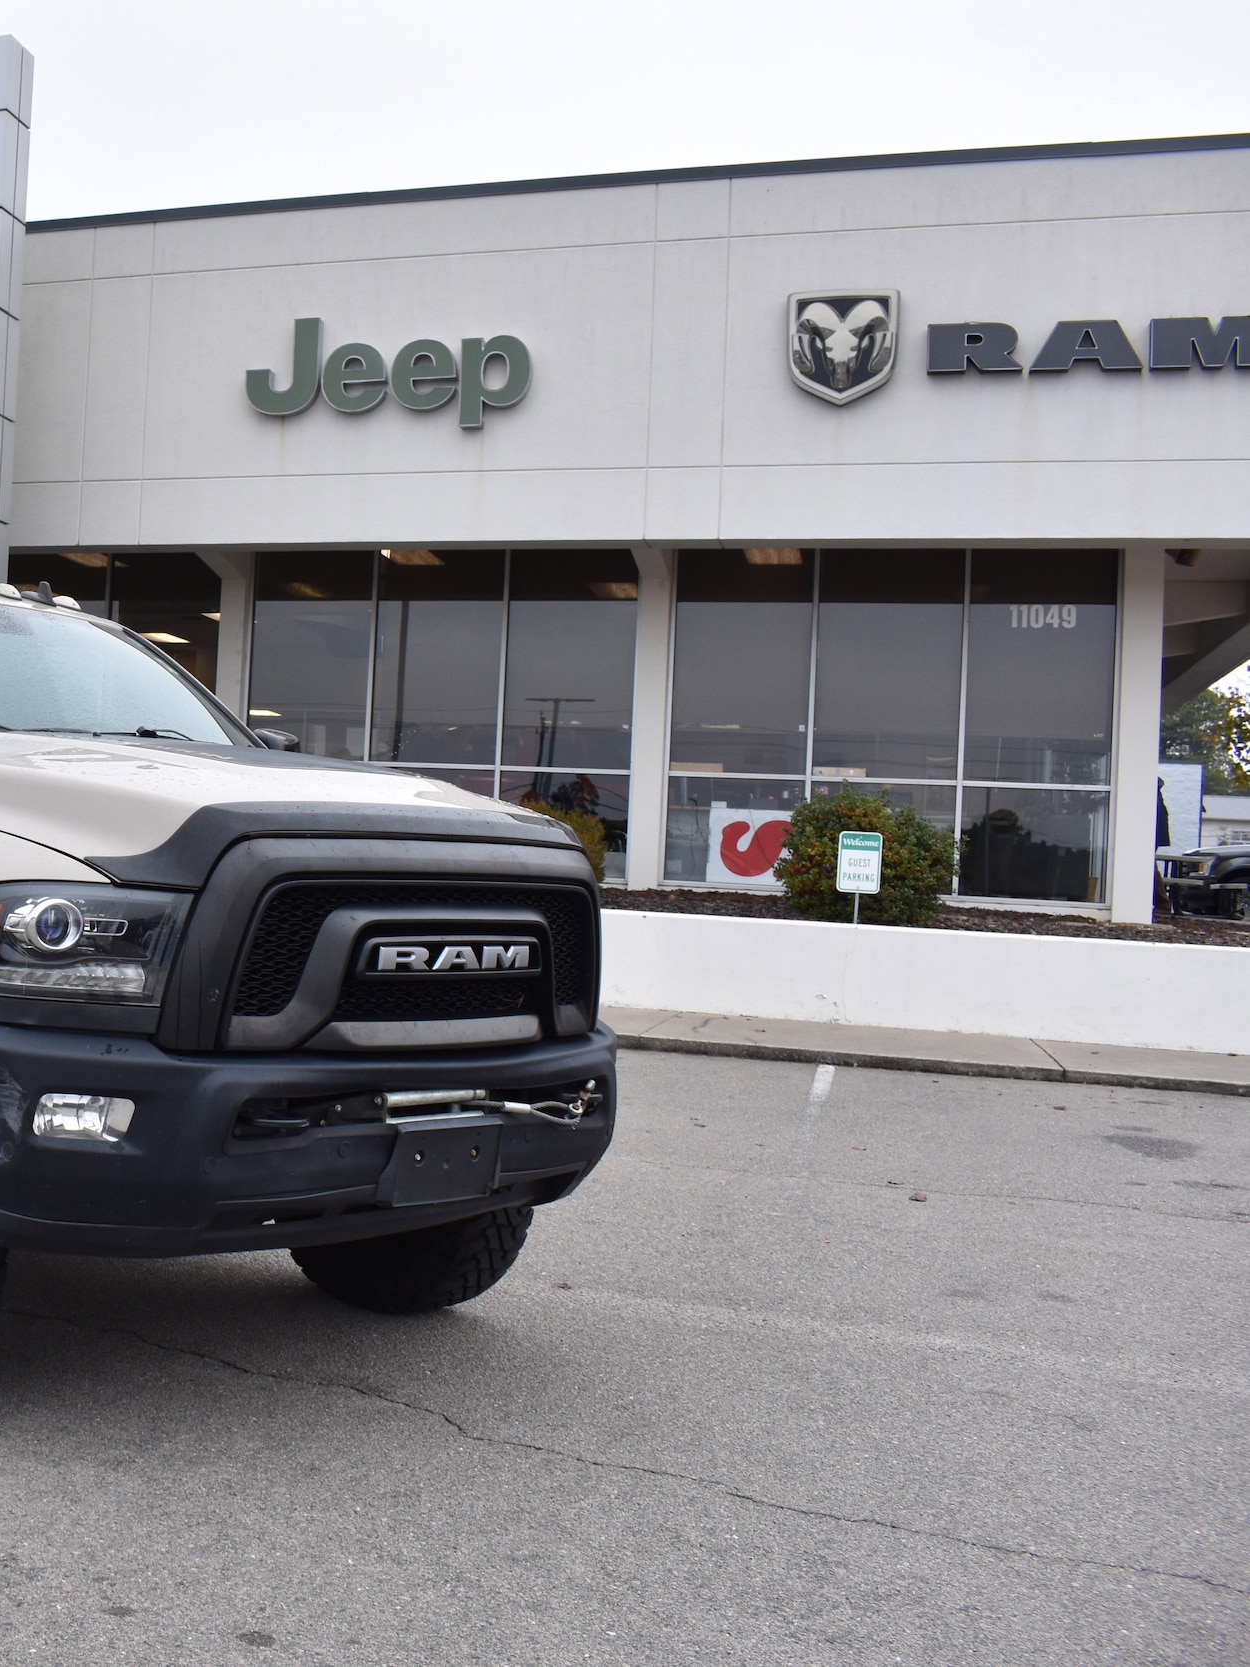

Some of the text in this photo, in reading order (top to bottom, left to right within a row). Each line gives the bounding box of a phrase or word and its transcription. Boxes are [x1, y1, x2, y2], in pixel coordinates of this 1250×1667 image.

[927, 315, 1250, 376] RAM
[245, 317, 533, 430] Jeep
[1010, 604, 1077, 628] 11049
[843, 836, 879, 847] Welcome
[848, 858, 871, 867] GUEST
[842, 872, 875, 883] PARKING
[377, 945, 530, 971] RAM
